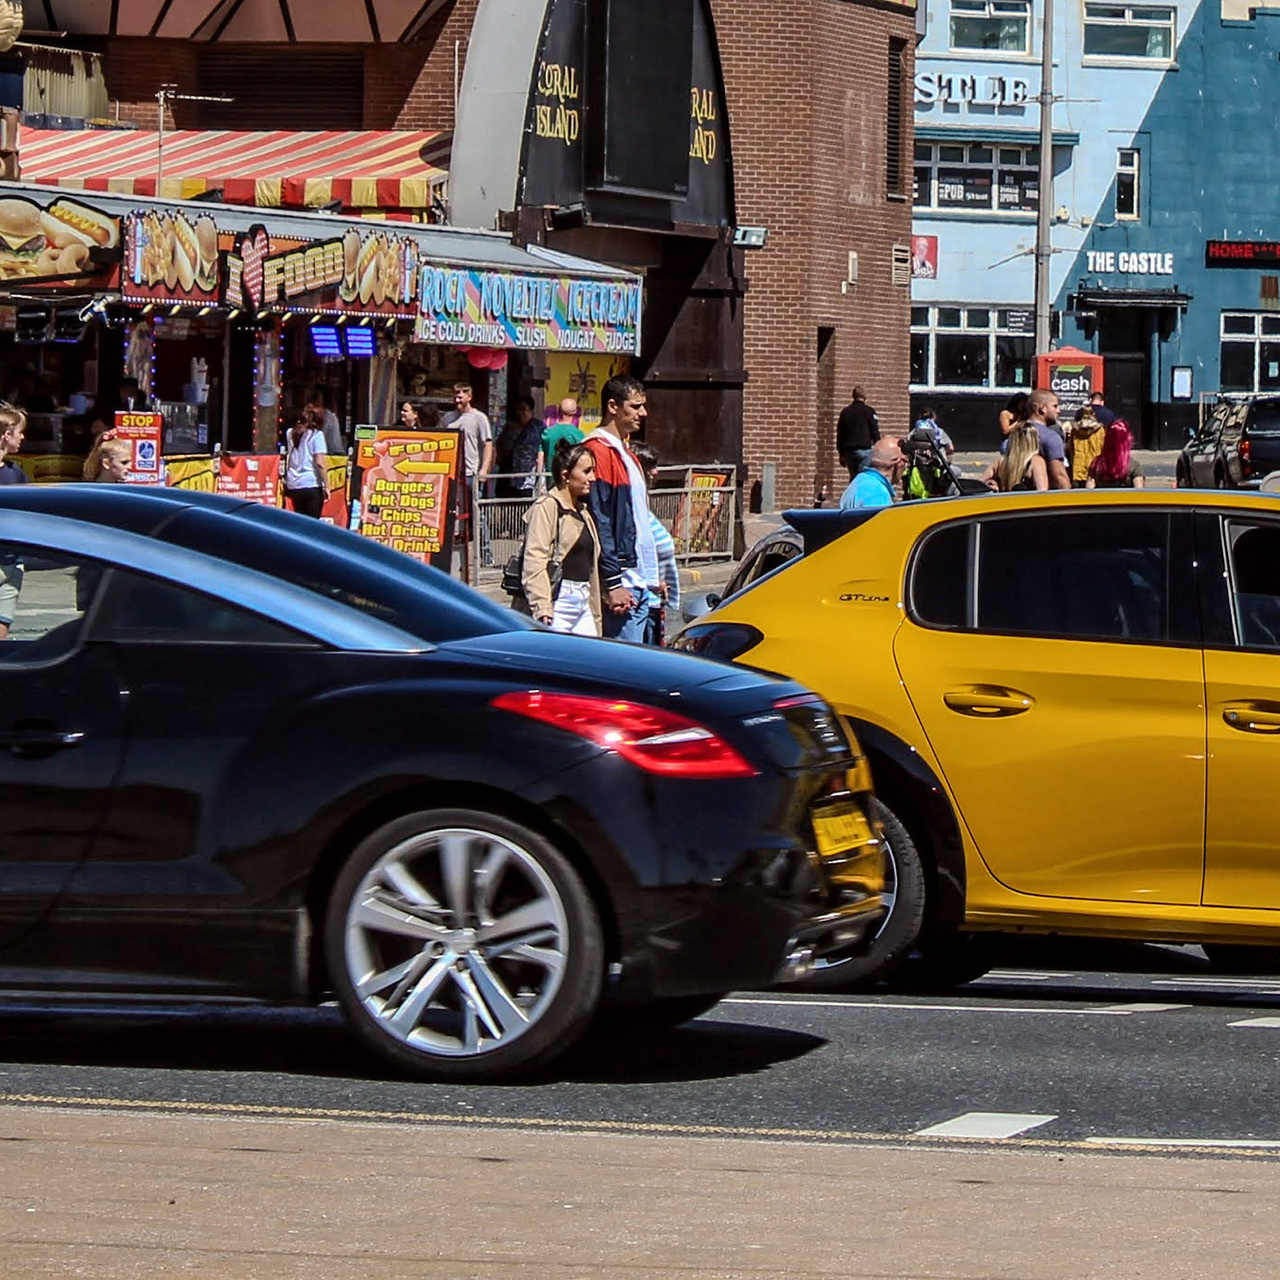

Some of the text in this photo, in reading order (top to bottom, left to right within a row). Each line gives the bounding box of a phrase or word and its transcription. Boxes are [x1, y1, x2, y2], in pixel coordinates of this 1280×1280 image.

[538, 61, 578, 103] CORAL
[914, 72, 1028, 106] STLE
[691, 87, 716, 124] RAL
[536, 104, 579, 145] ISLAND
[945, 185, 964, 199] PUB
[1087, 252, 1173, 274] THE CASTLE
[226, 240, 344, 306] I FOOD
[421, 265, 466, 315] ROCK
[480, 272, 559, 320] NOVELTIES
[420, 320, 635, 350] ICE COLD DRINKS SLUSH NOUGAT FUDGE
[1051, 375, 1089, 391] cash
[122, 415, 154, 426] STOP
[363, 440, 455, 457] I FOOD
[375, 479, 433, 494] Burgers
[371, 494, 435, 509] Hot Dogs
[382, 508, 422, 523] Chips
[362, 523, 438, 537] Hot Drinks
[393, 539, 441, 553] Drinks
